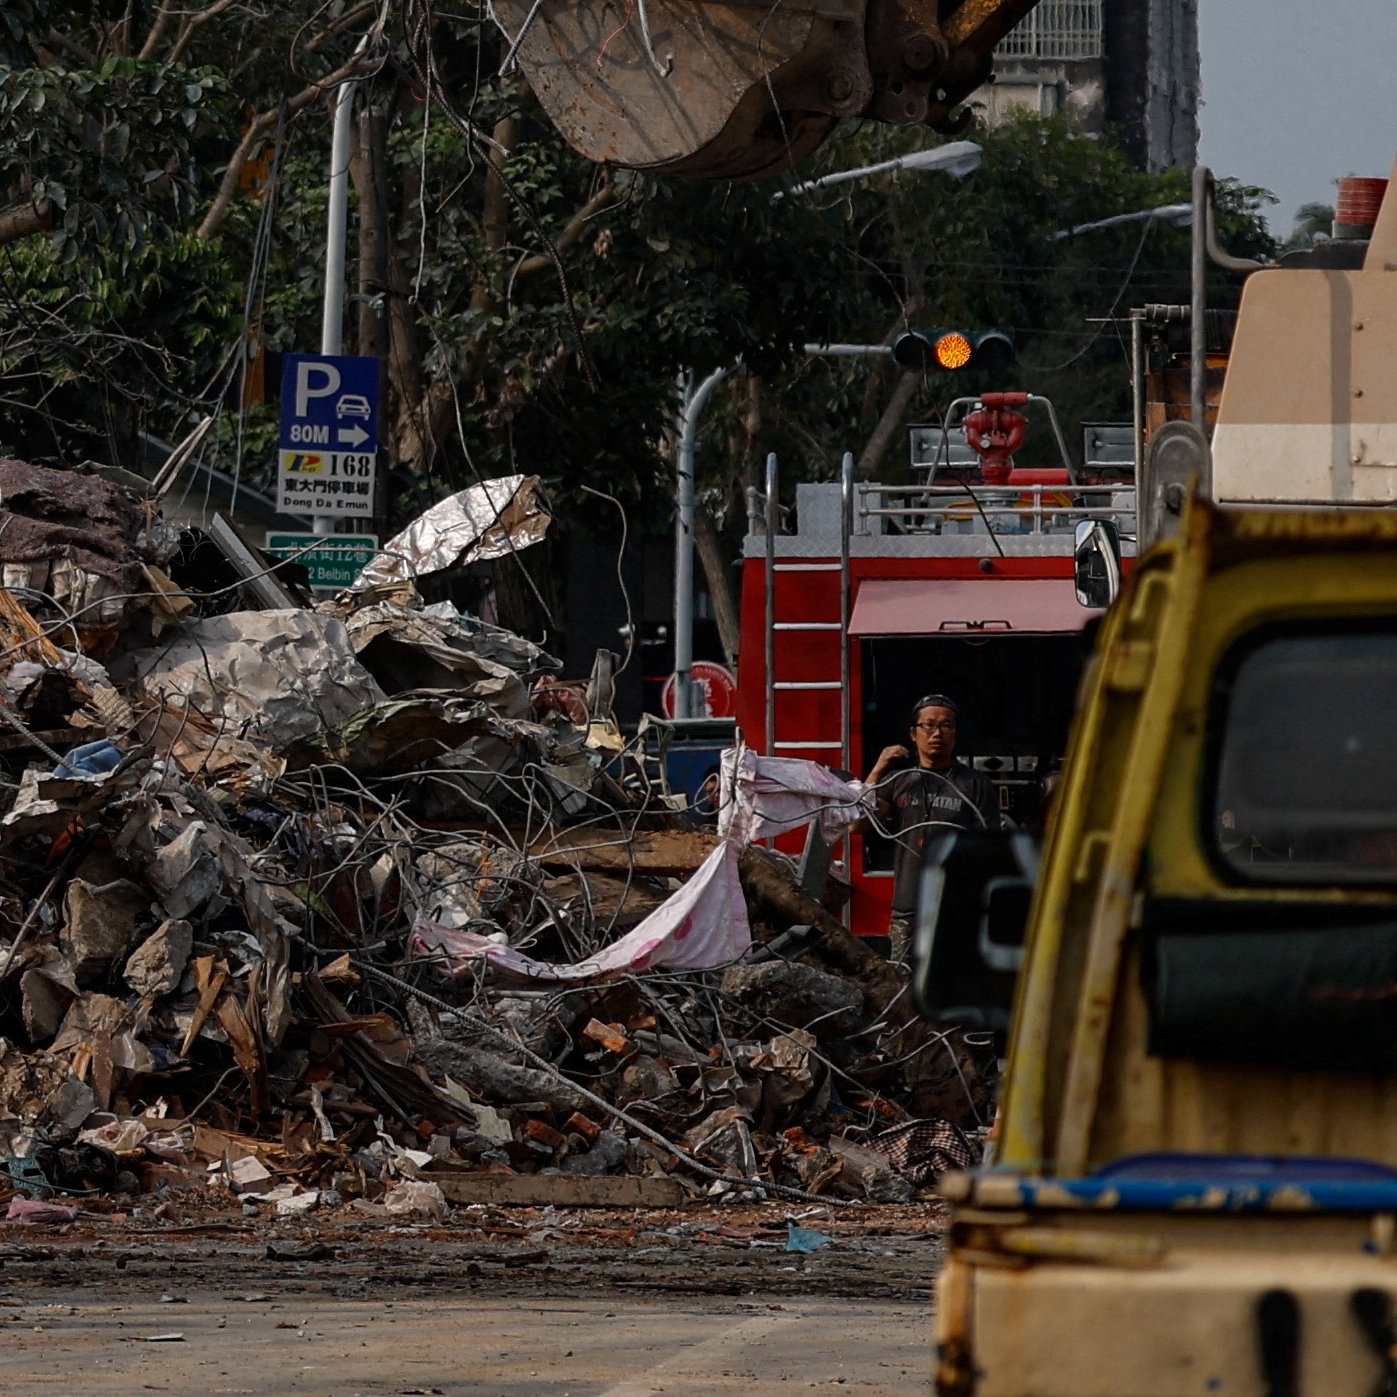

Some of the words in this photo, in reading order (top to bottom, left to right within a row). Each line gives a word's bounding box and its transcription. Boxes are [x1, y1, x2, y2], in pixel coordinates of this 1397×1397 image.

[295, 361, 342, 418] P
[290, 423, 330, 445] 80M
[330, 454, 371, 478] 168
[284, 478, 371, 496] 東大門停車場
[283, 497, 313, 509] Dong
[316, 498, 332, 508] Da
[317, 566, 351, 581] Beibin
